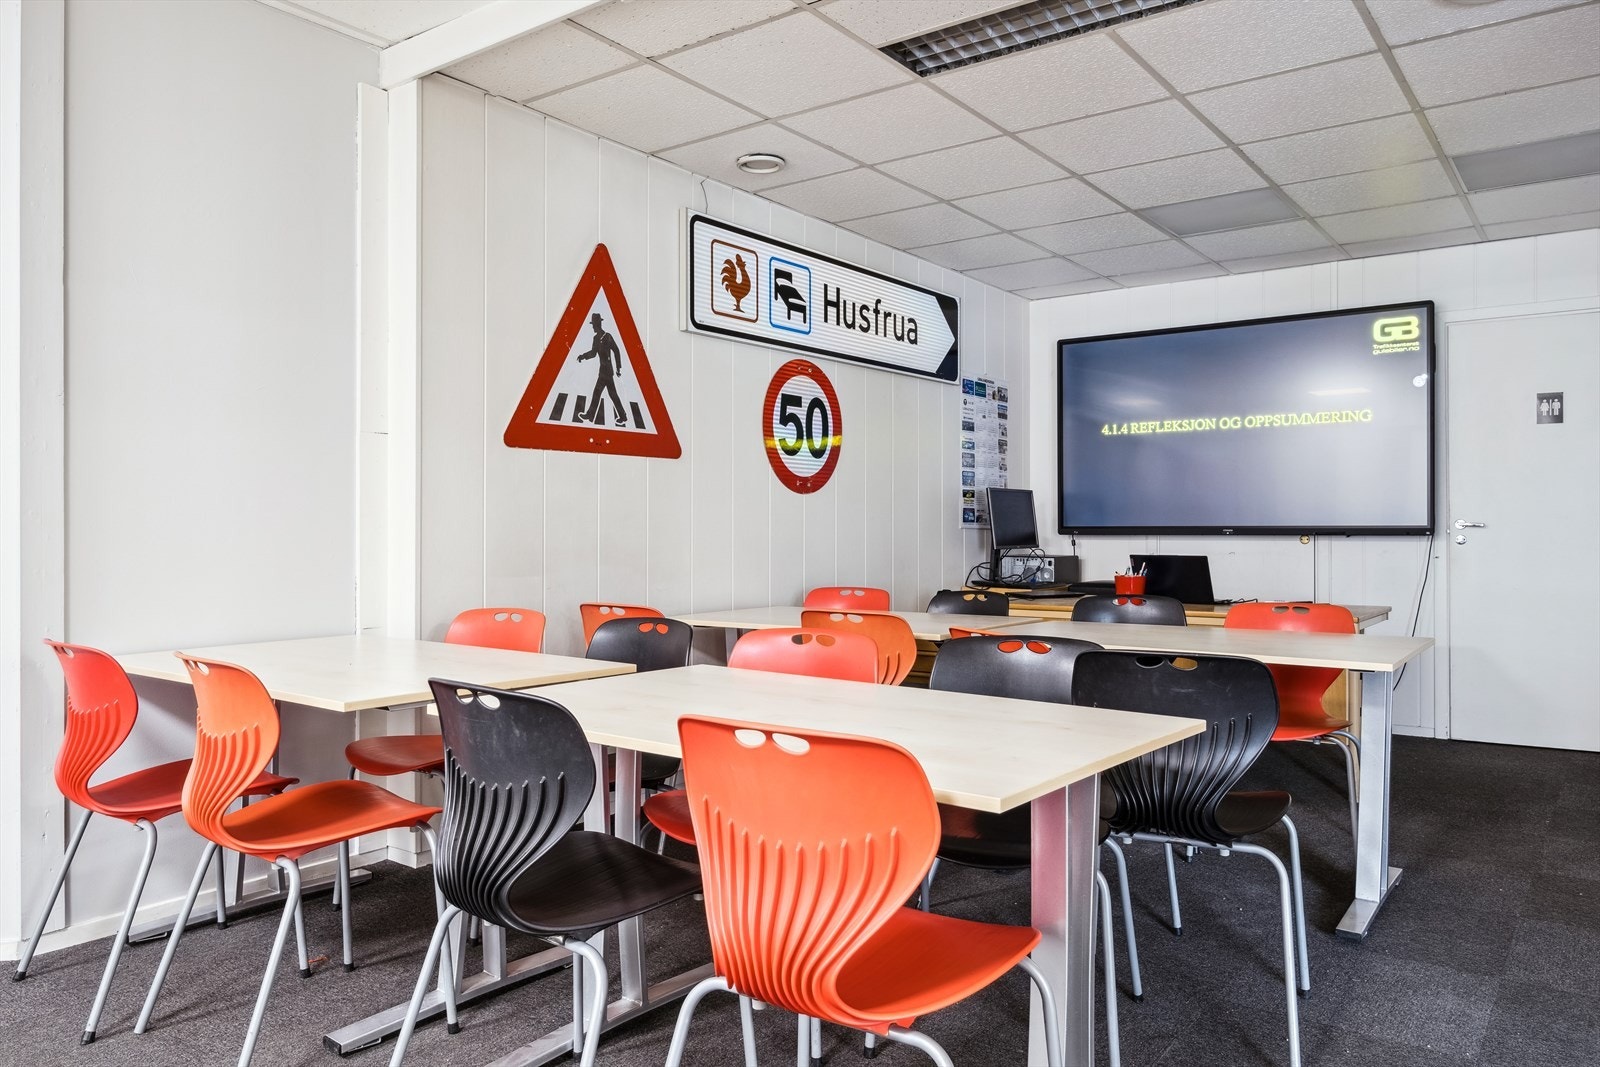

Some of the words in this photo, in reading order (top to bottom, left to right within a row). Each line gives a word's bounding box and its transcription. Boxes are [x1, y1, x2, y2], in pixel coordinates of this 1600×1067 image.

[823, 283, 918, 346] Husfrua
[1373, 316, 1420, 342] GB
[778, 393, 829, 459] 50
[1101, 424, 1129, 436] 4.1.4
[1130, 418, 1217, 434] REFLEKSJON
[1219, 416, 1242, 430] OG
[1244, 409, 1373, 428] OPPSUMMERING
